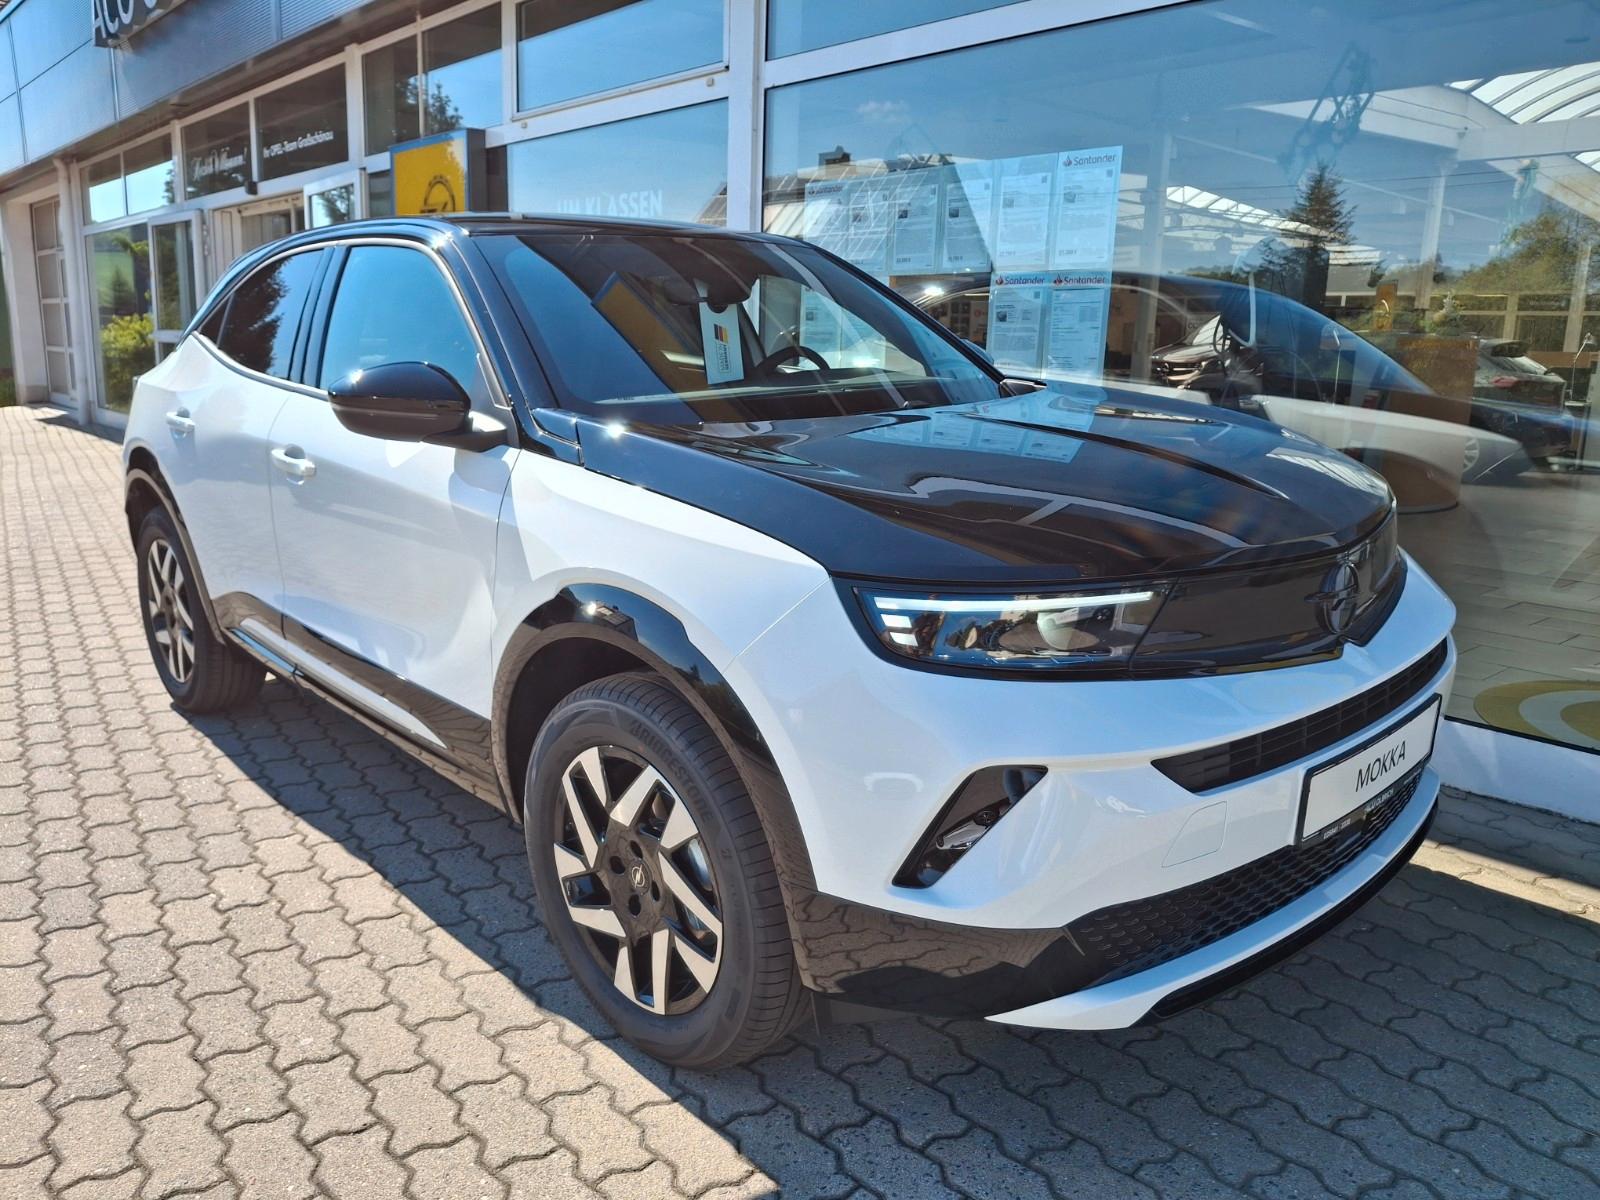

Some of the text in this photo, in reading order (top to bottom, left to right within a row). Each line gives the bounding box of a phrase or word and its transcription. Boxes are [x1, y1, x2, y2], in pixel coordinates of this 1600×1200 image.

[1073, 154, 1116, 167] Santander
[584, 189, 664, 218] KLASSEN
[1004, 275, 1046, 286] Santander
[1063, 274, 1106, 286] Santander
[1355, 740, 1406, 793] MOKKA
